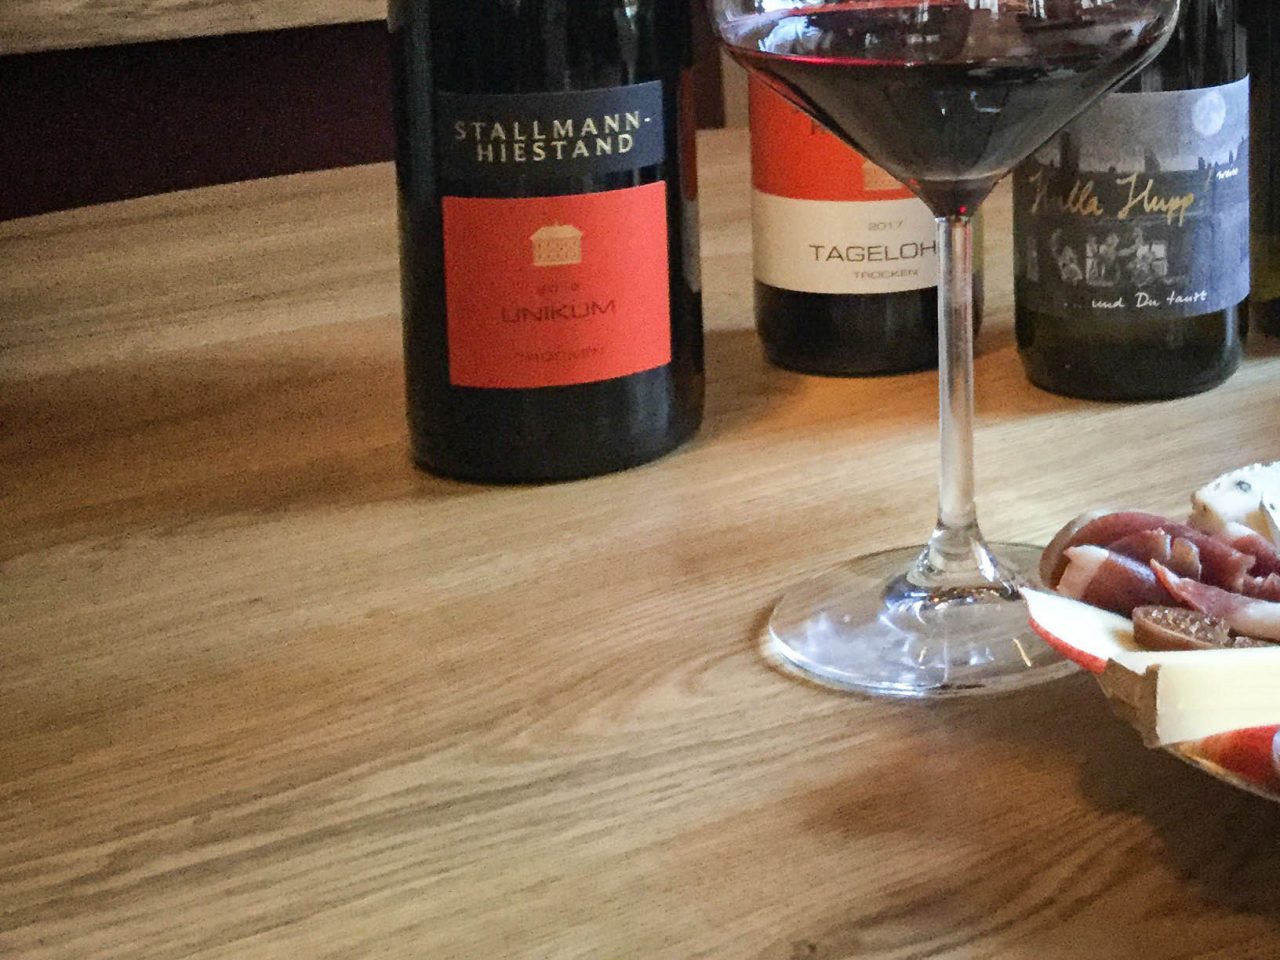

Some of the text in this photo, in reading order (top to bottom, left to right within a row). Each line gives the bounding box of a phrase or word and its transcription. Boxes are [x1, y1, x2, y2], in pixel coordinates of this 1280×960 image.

[454, 110, 651, 140] STALLMANN-
[477, 134, 633, 162] HIESTAND
[867, 221, 904, 231] 2017
[809, 241, 937, 262] TAGELOH
[854, 269, 918, 279] TROCKEN
[1092, 296, 1125, 308] und
[1135, 292, 1161, 308] Du
[502, 299, 616, 323] UNIKUM
